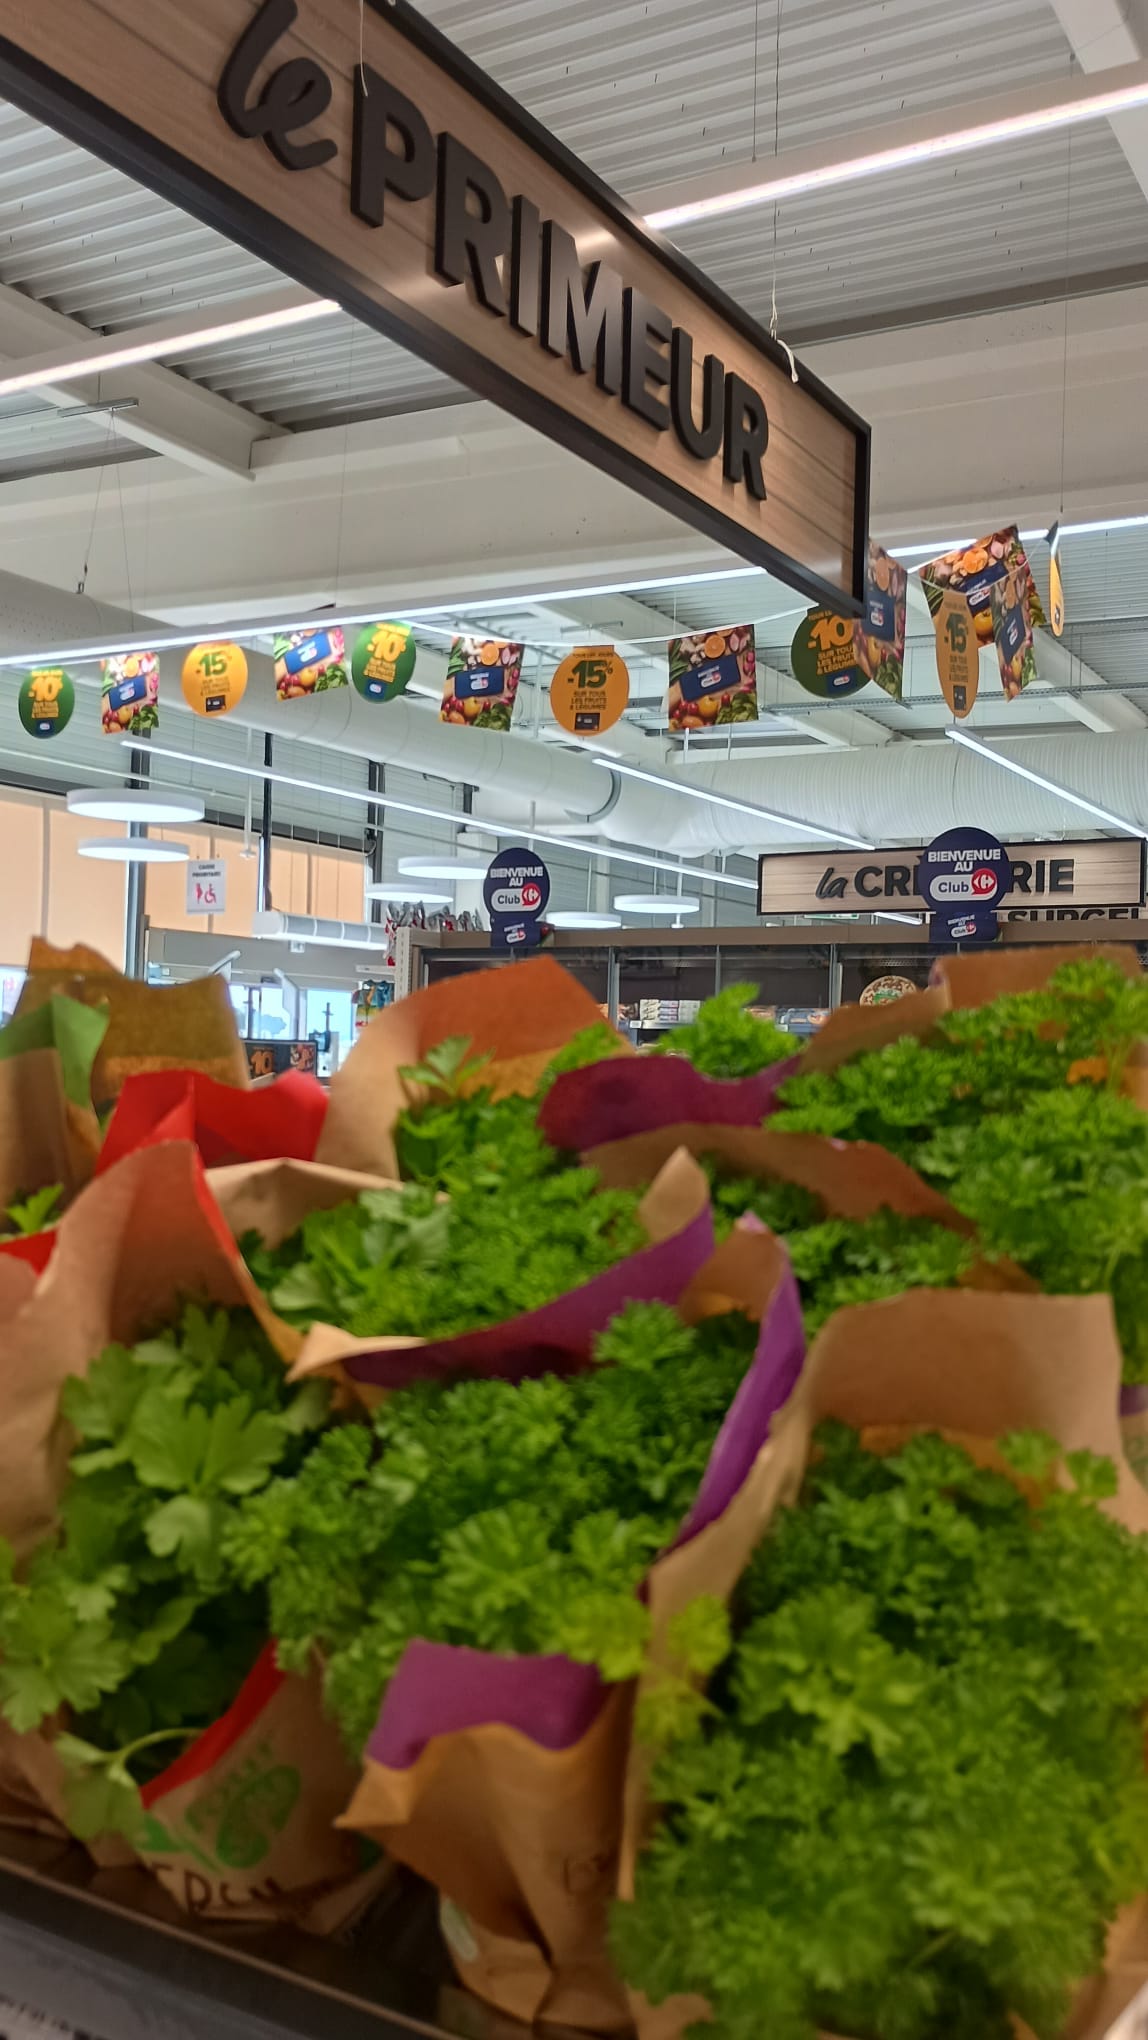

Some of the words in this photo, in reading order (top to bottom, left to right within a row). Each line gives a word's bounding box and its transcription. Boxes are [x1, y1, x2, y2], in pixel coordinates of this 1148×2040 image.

[217, 0, 338, 170] le
[350, 63, 768, 501] PRIMEUR
[927, 848, 1002, 863] BIENVENUE
[490, 866, 544, 879] BIENVENUE
[953, 861, 974, 873] AU
[508, 877, 524, 888] AU
[815, 866, 848, 899] la
[937, 881, 970, 894] Club
[496, 894, 521, 905] Club
